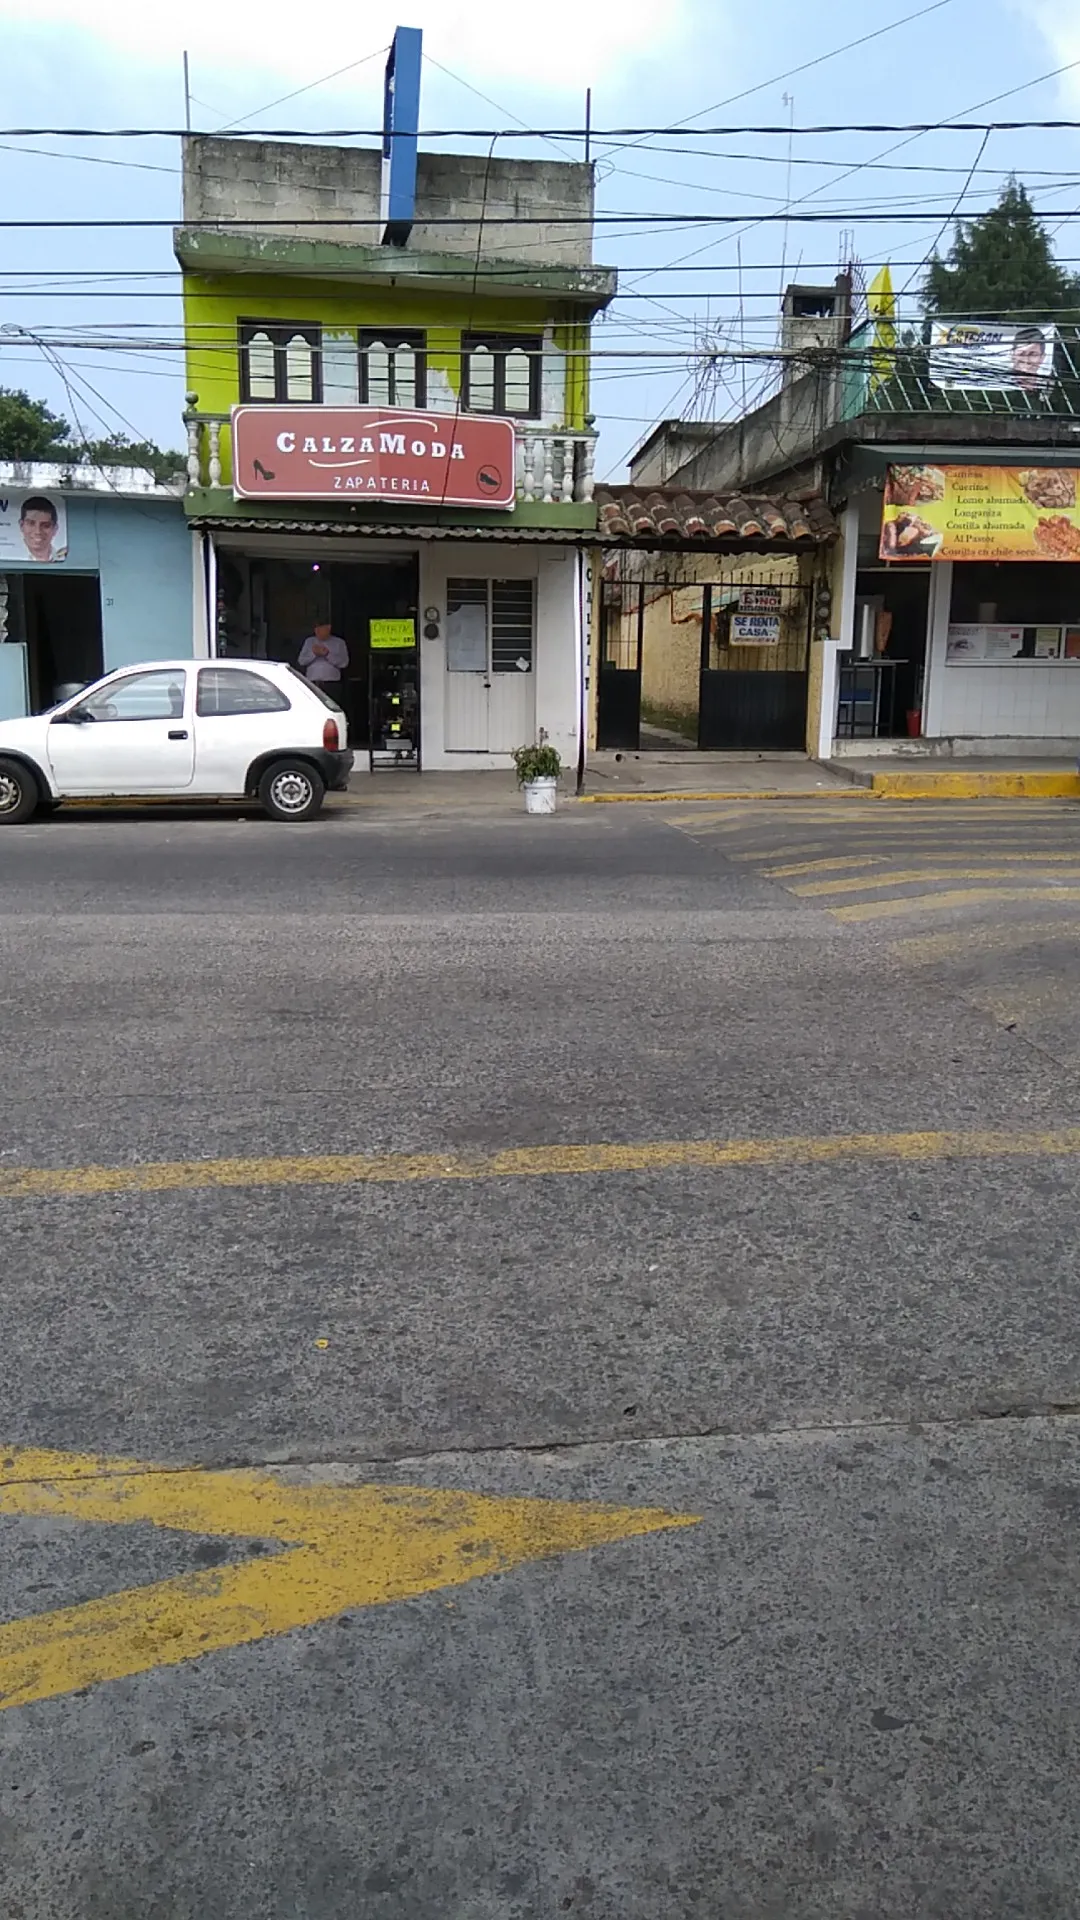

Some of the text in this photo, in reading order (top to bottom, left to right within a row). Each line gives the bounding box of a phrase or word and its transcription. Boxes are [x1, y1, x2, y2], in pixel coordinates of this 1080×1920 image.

[334, 476, 430, 493] ZAPATERIA
[952, 482, 989, 491] Cueritos
[957, 495, 1028, 504] Lomo ahumado
[954, 508, 1002, 519] Longaniza
[946, 520, 1025, 530] Costilla ahumada
[954, 534, 995, 542] Al Pastor
[941, 547, 976, 556] Costilla
[991, 547, 1013, 556] chile
[759, 597, 777, 605] NO
[734, 617, 779, 627] SE RENTA
